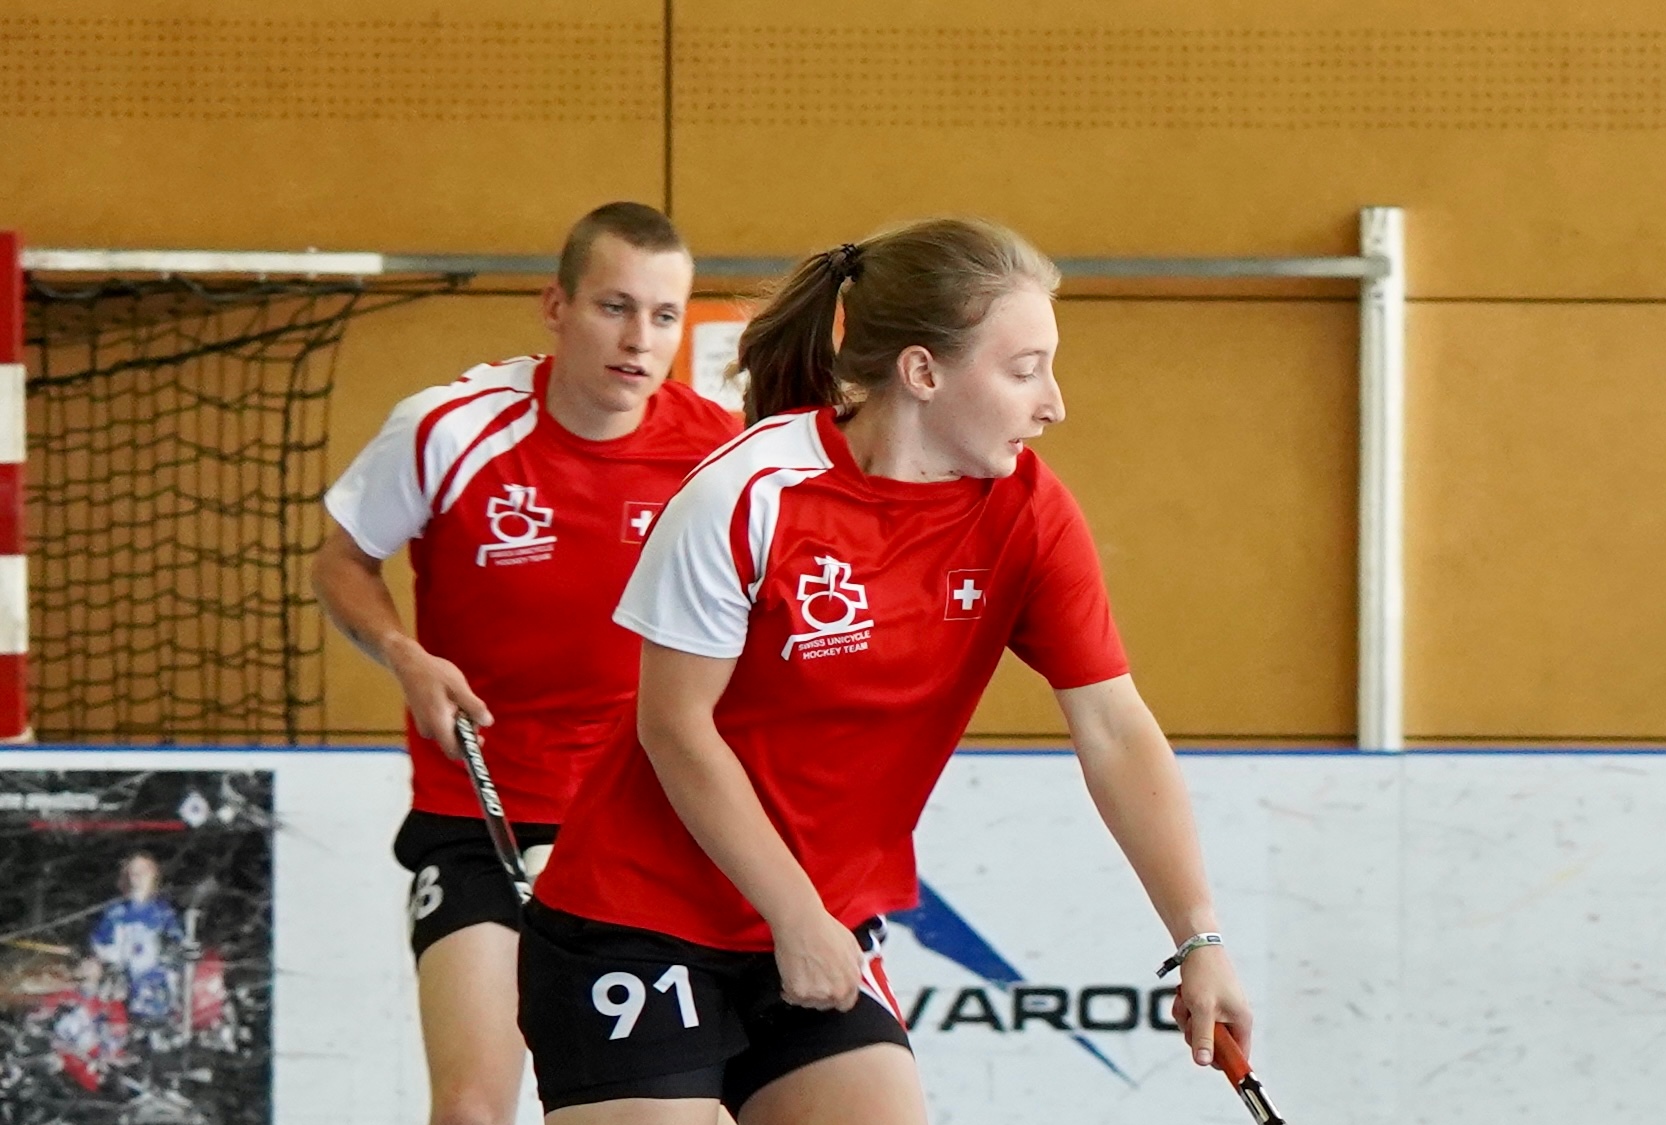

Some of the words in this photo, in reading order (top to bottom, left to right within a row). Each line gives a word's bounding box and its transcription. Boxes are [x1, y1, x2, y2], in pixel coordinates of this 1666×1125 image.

[803, 646, 842, 660] HOCKEY
[843, 641, 869, 655] TEAM
[591, 964, 700, 1041] 91
